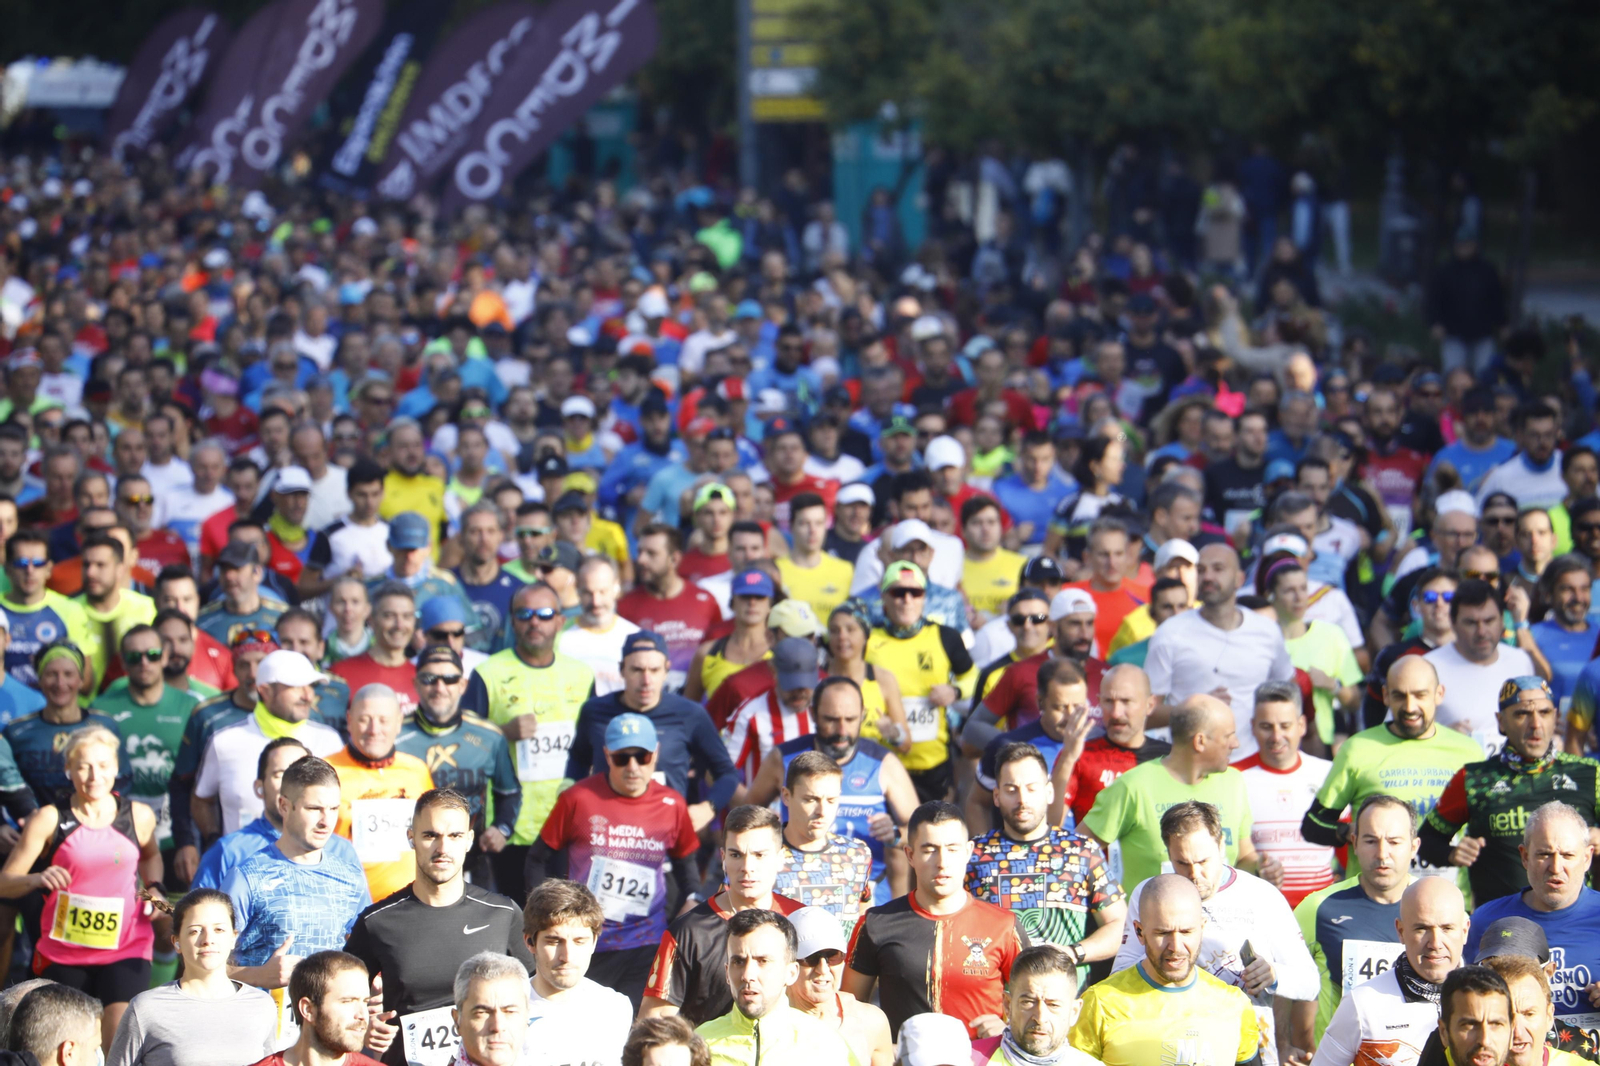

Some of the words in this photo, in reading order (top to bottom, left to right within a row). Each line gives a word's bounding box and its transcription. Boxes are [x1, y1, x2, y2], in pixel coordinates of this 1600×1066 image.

[530, 734, 572, 755] 3342
[590, 833, 605, 847] 36
[608, 837, 665, 851] MARATÓN
[608, 825, 645, 838] MEDIA
[601, 872, 650, 899] 3124
[69, 906, 118, 932] 1385
[1358, 957, 1397, 980] 46
